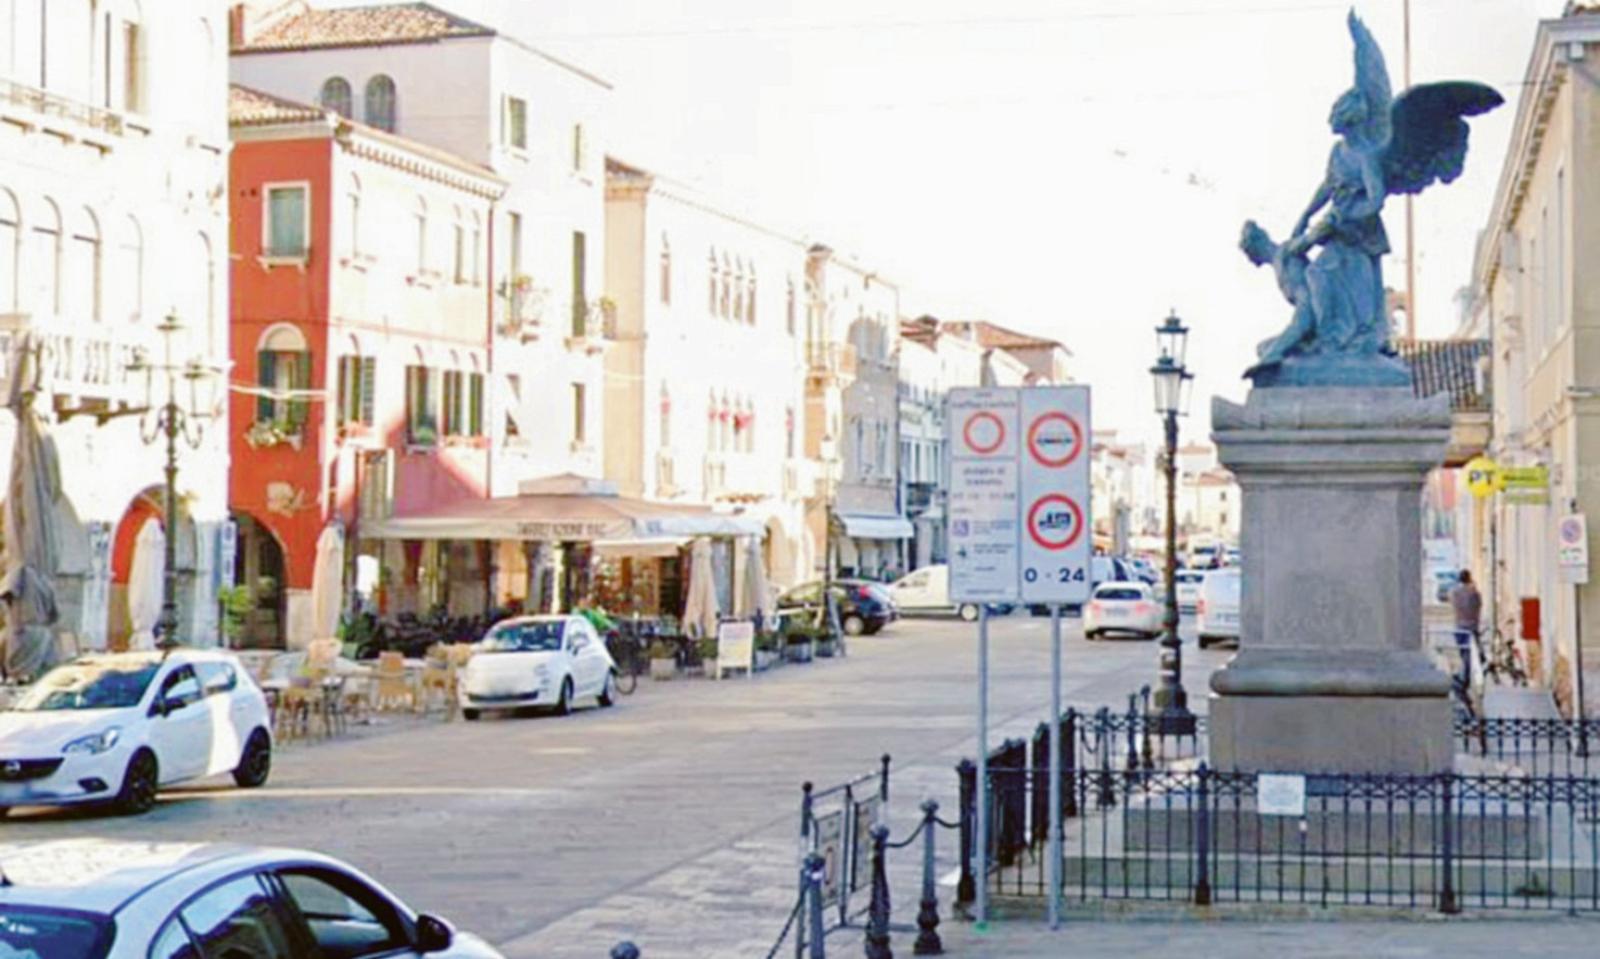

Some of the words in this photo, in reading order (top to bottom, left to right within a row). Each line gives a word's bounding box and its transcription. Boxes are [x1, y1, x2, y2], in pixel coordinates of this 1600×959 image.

[1469, 470, 1495, 485] PT
[1024, 567, 1038, 582] 0
[1058, 567, 1085, 582] 24
